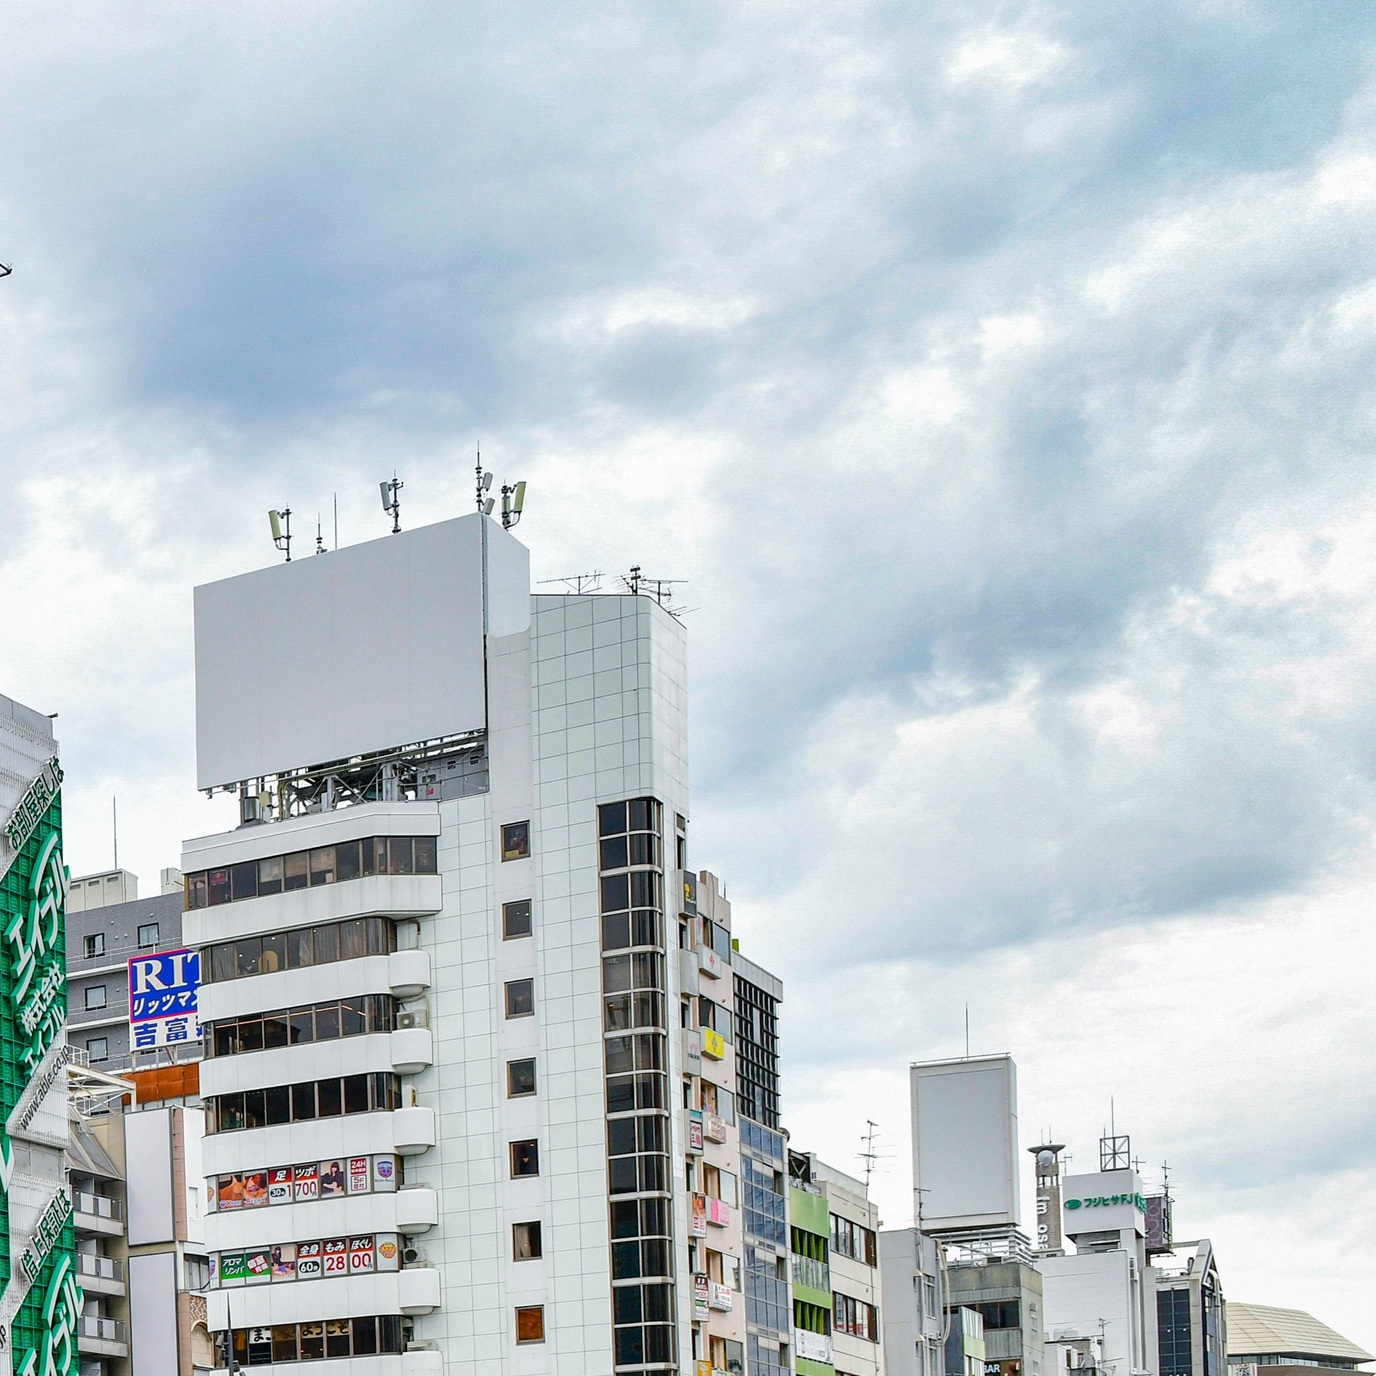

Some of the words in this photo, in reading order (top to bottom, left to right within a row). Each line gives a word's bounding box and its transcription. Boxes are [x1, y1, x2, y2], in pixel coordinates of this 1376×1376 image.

[5, 756, 64, 850] お部屋探しは
[5, 832, 71, 1005] エイブル
[16, 960, 65, 1038] 株式会社
[21, 1005, 65, 1078] エイブル
[19, 1044, 70, 1130] www.able.co.jp
